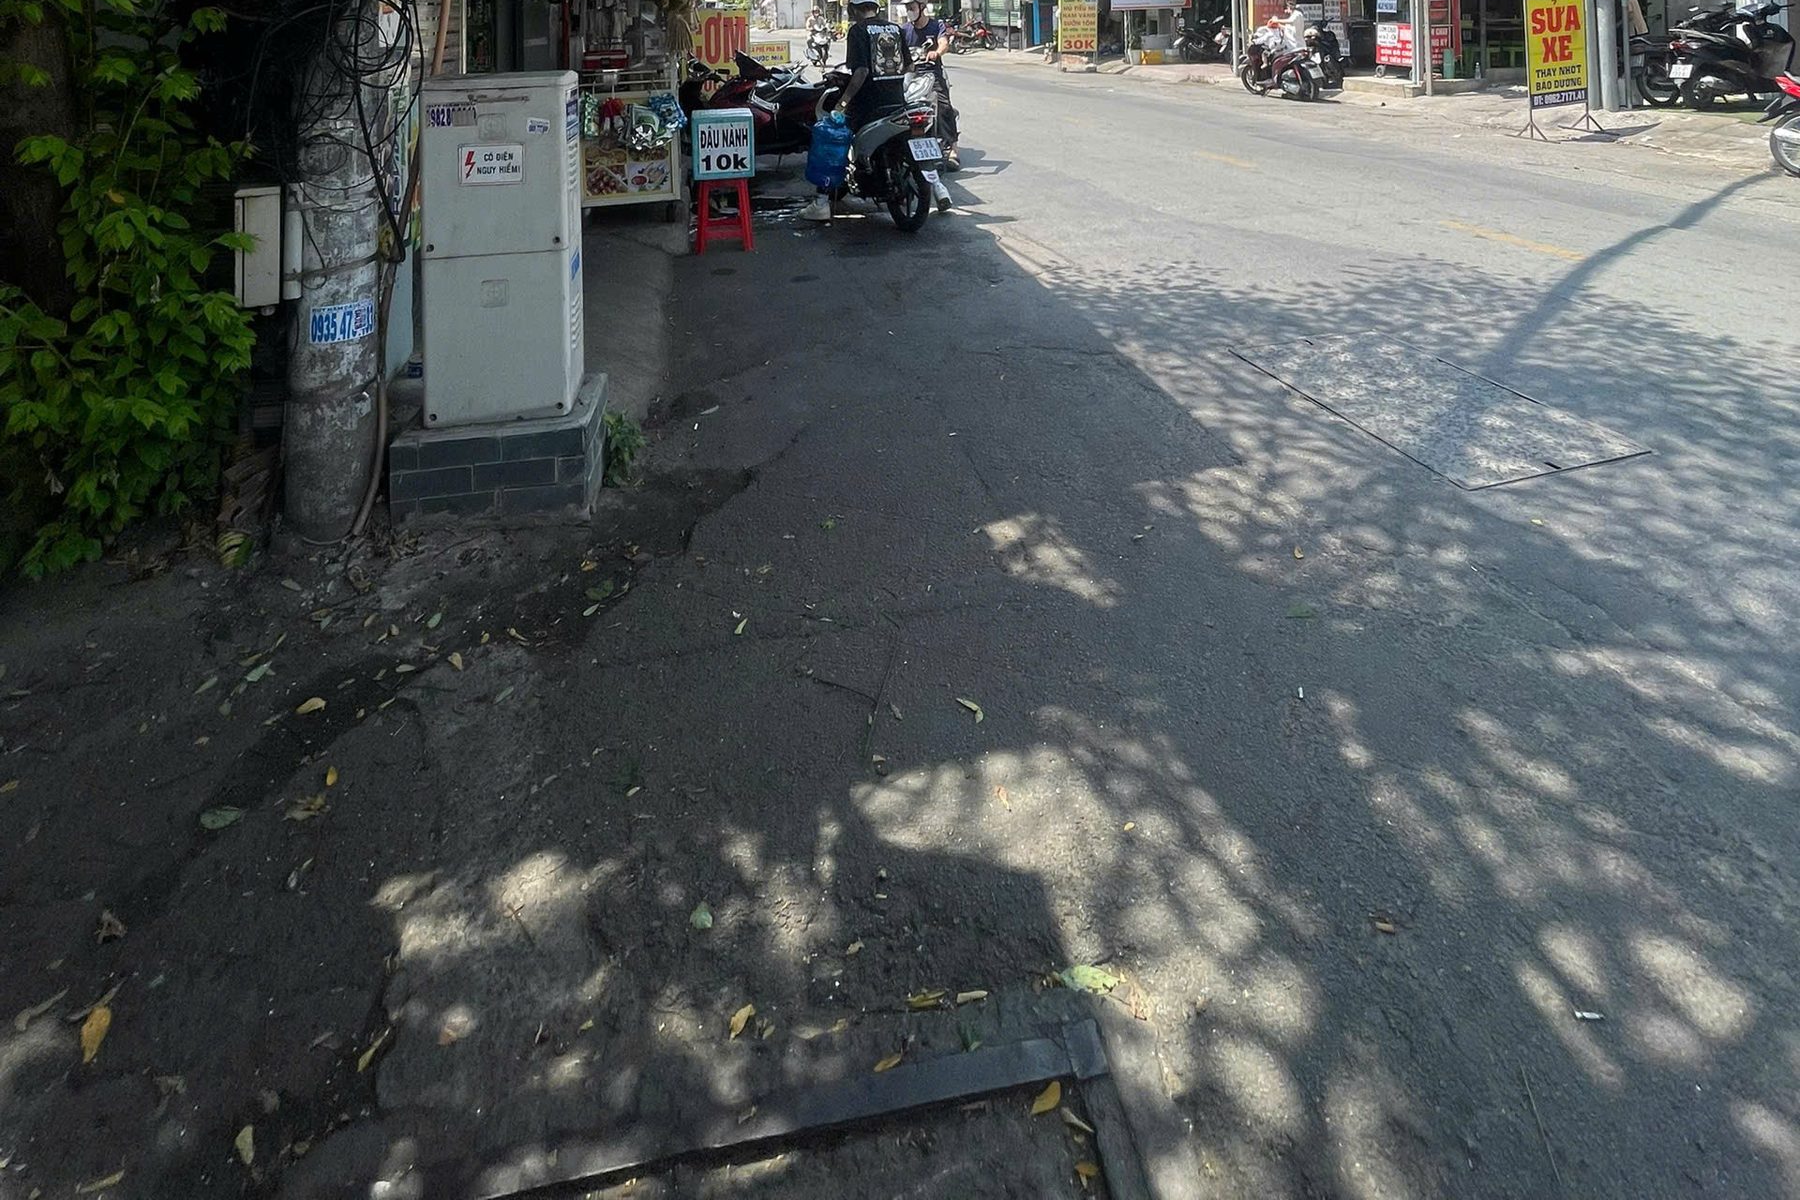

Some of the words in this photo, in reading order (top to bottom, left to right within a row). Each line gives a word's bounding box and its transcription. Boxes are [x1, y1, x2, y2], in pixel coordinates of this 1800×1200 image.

[1531, 0, 1581, 35] SỬA
[1063, 40, 1095, 50] 30K
[1542, 35, 1573, 63] XE
[1535, 67, 1557, 79] THAY
[722, 123, 748, 148] NÀNH
[477, 166, 497, 175] NGUY
[701, 153, 748, 171] 10k
